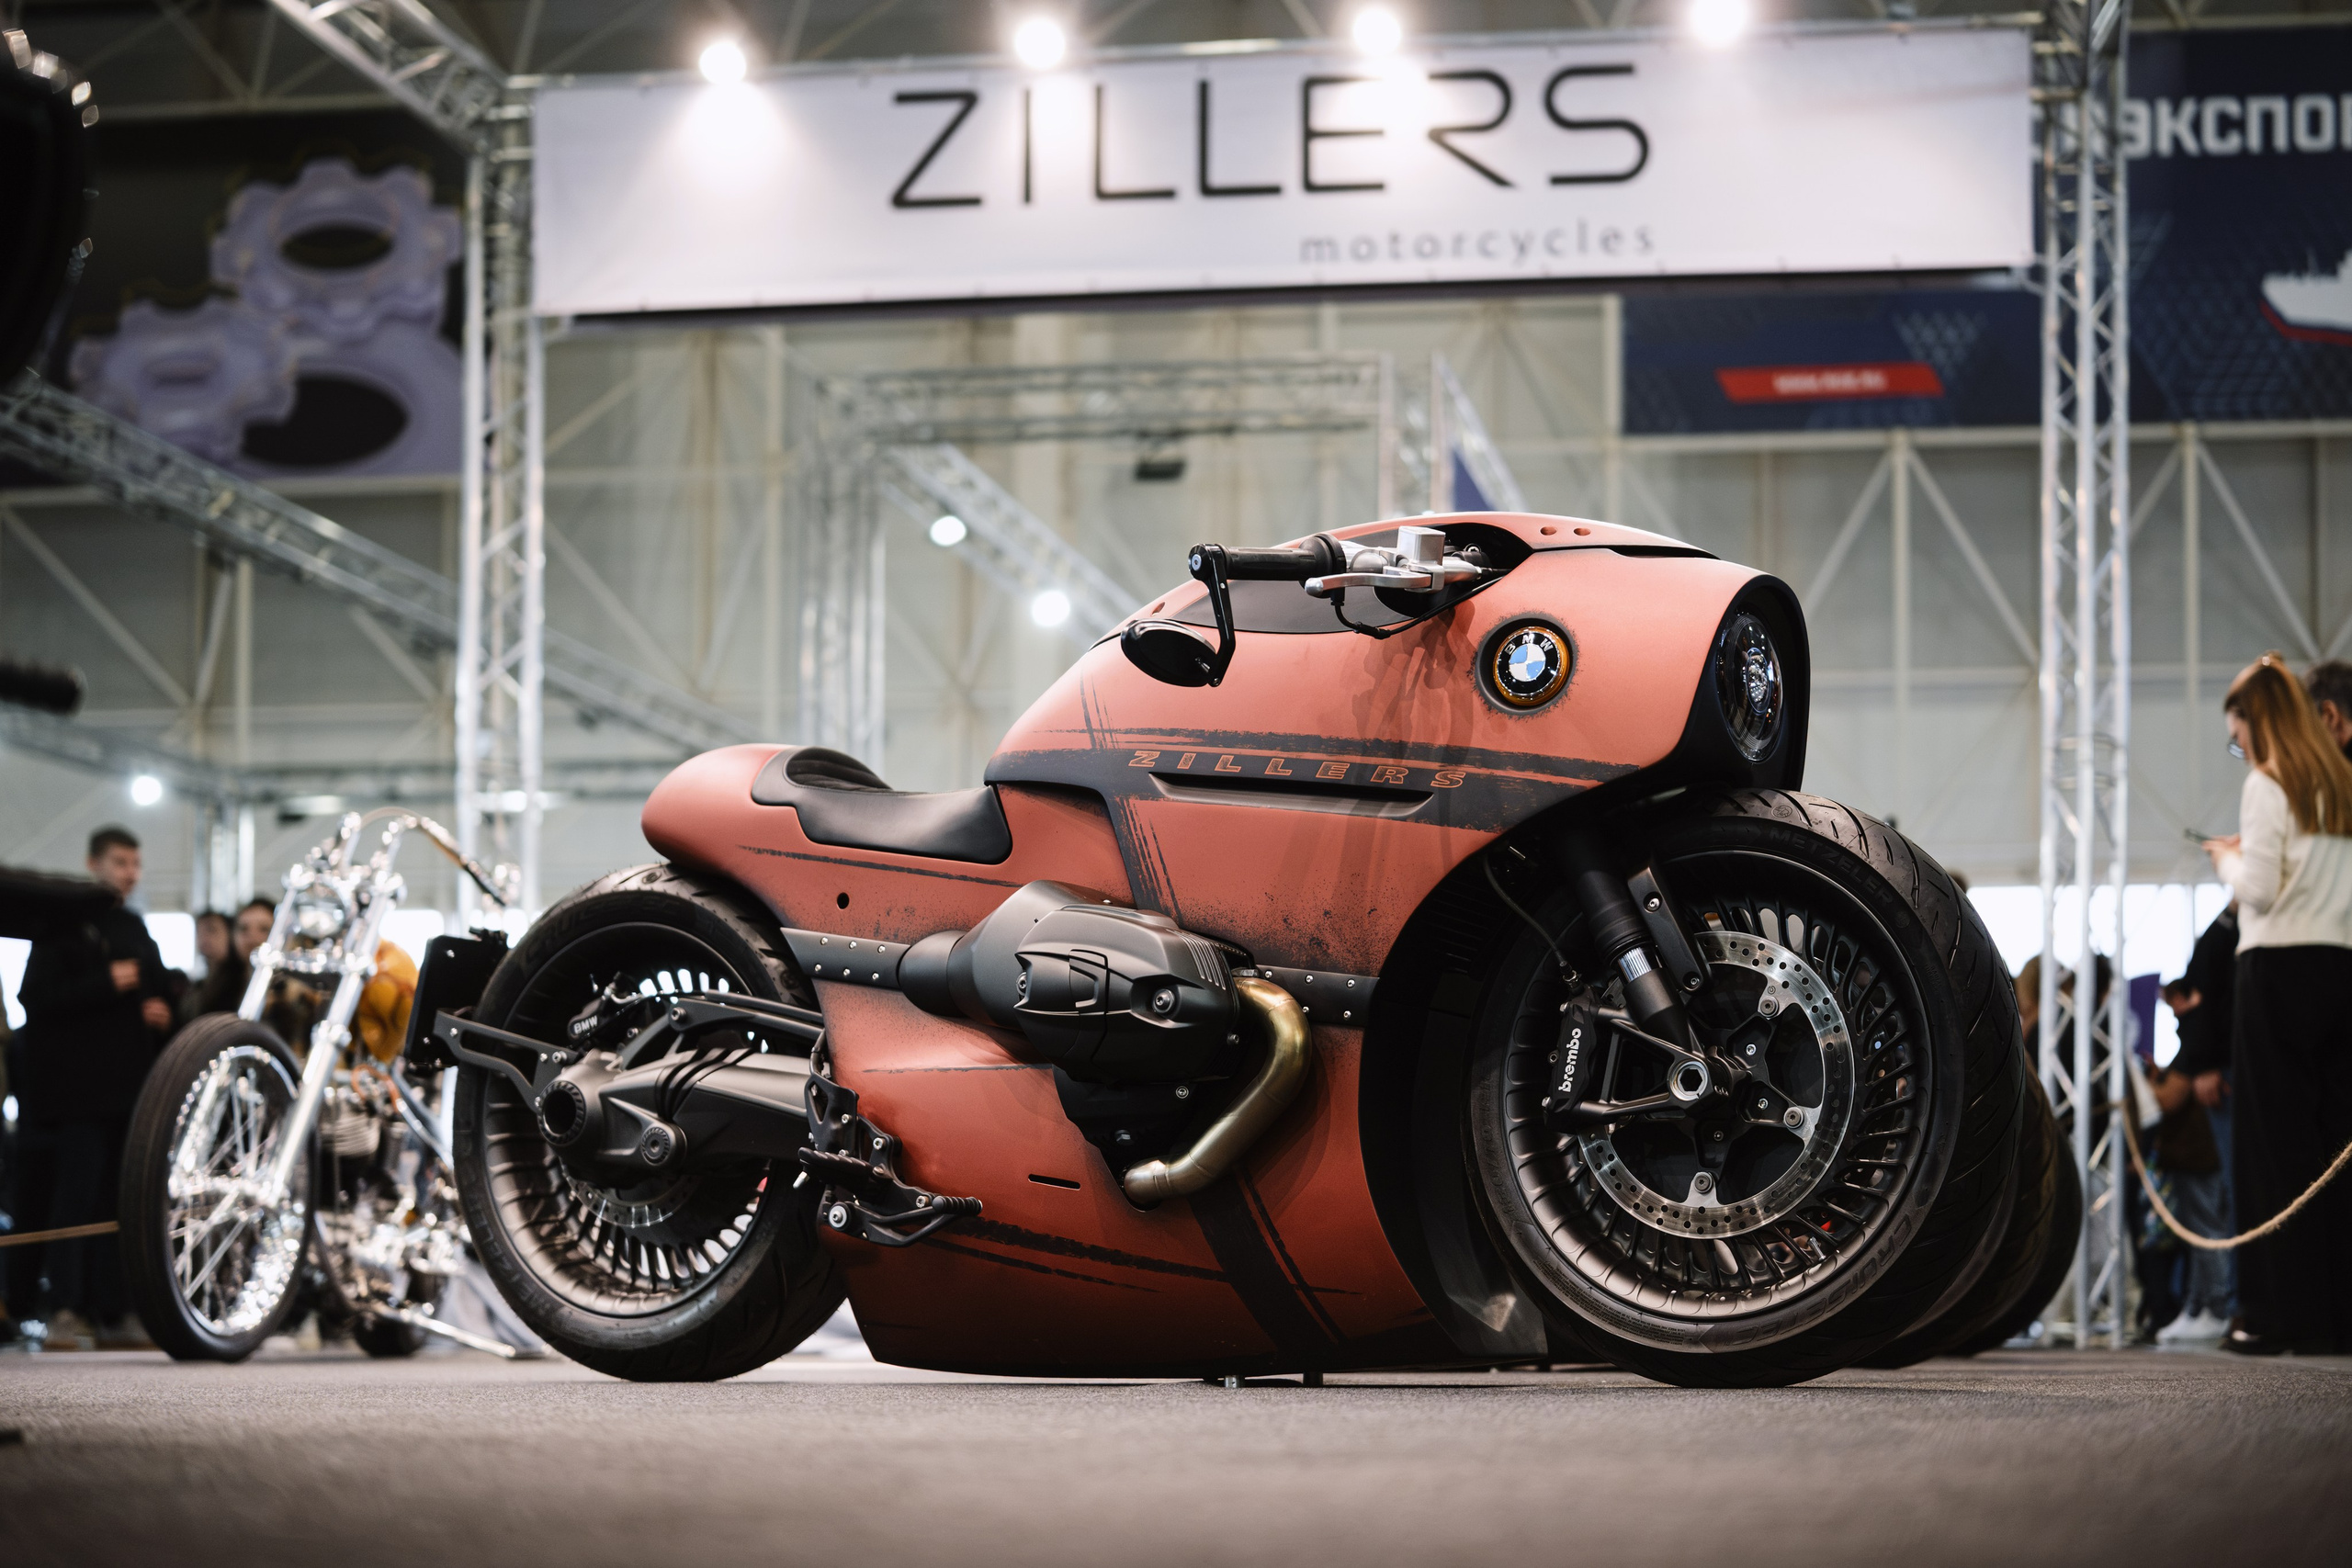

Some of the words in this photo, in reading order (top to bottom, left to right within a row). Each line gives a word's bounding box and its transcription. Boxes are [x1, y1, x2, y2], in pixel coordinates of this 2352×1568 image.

[891, 62, 1650, 209] ZILLERS
[1299, 220, 1656, 267] motorcycles
[1504, 633, 1554, 655] BMW
[1128, 750, 1466, 788] ZILLERS
[1768, 829, 1895, 907] METZELER
[573, 1014, 598, 1035] BMW
[1558, 1028, 1582, 1092] brembo
